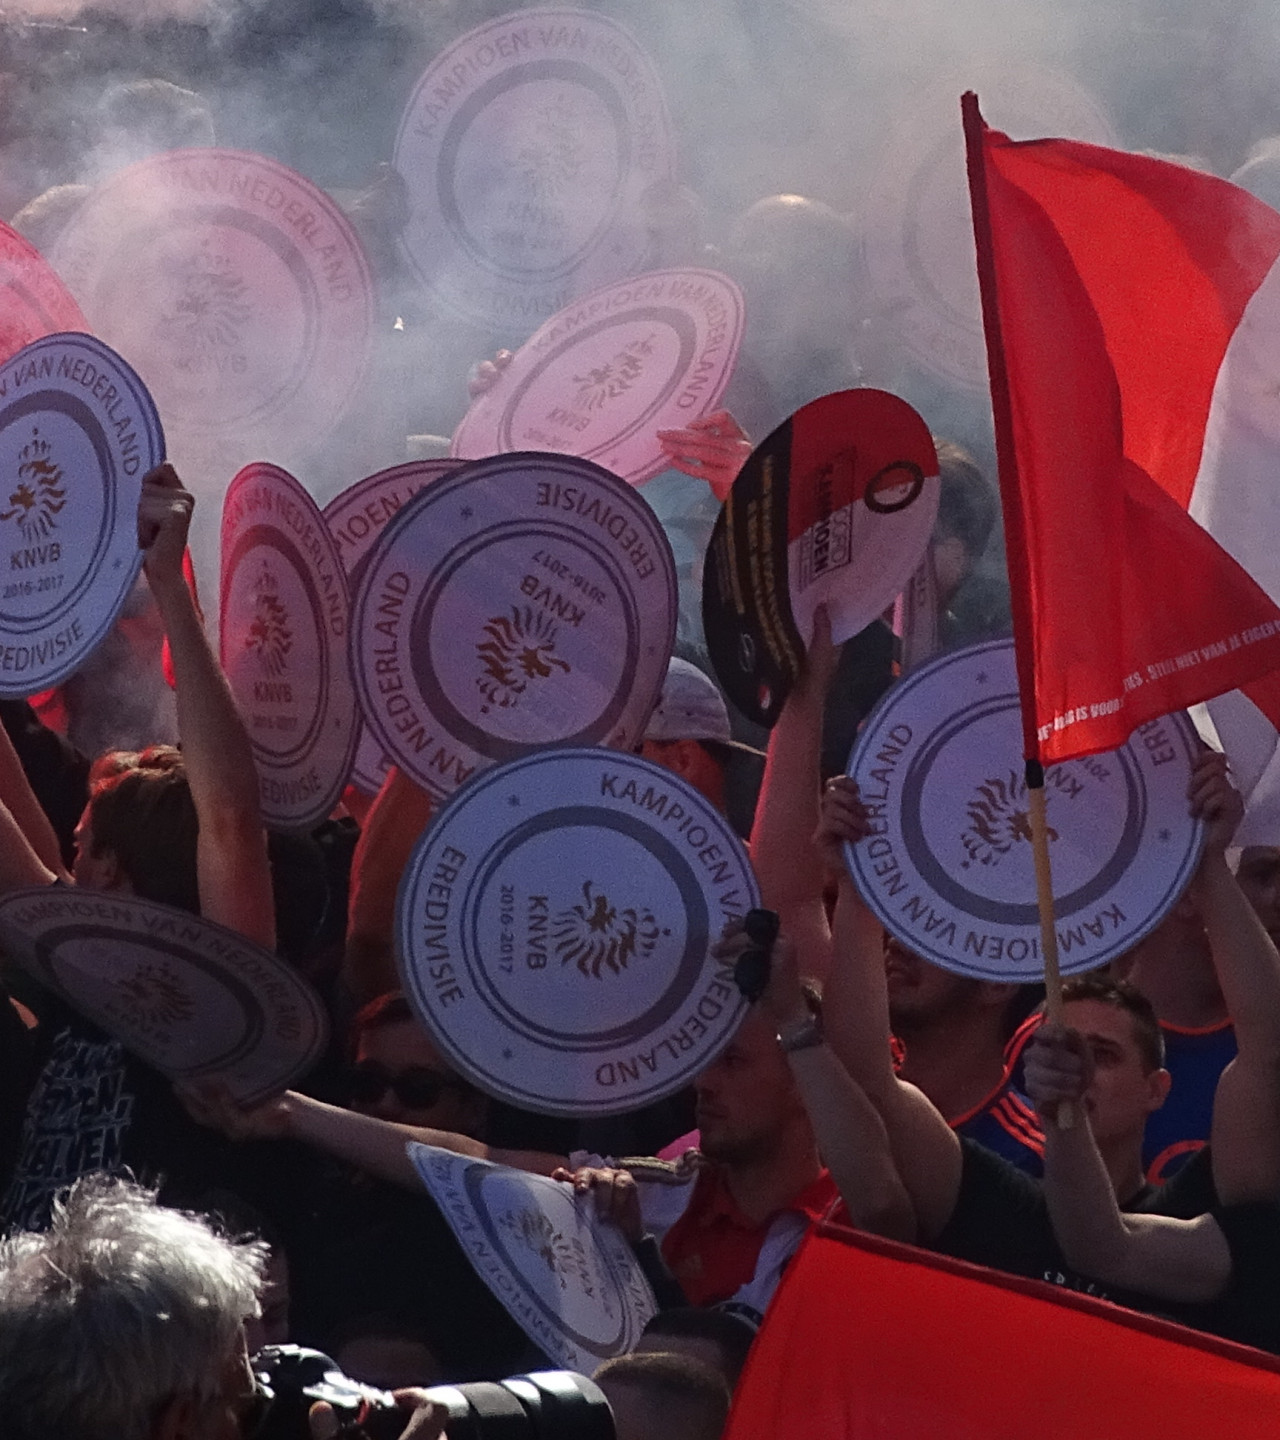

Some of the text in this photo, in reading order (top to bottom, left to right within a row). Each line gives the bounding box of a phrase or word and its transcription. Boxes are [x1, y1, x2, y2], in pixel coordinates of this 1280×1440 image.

[413, 27, 532, 140] KAMPIOEN
[228, 170, 354, 303] NEDERLAND
[531, 281, 666, 353] KAMPIOEN
[676, 290, 729, 410] NEDERLAND
[14, 358, 61, 388] VAN
[58, 354, 141, 477] NEDERLAND
[9, 543, 62, 571] KNVB
[275, 491, 346, 637] NEDERLAND
[531, 550, 608, 605] 2016-2017
[535, 481, 656, 581] EREDIVISIE
[2, 573, 66, 600] 2016-2017
[519, 574, 587, 628] KNVB
[253, 681, 293, 704] KNVB
[373, 570, 477, 787] AN NEDERLAND
[259, 766, 323, 808] EDIVISIE
[1045, 766, 1085, 800] KN
[866, 723, 1128, 962] KAMIOEN VAN NEDERLAND
[143, 913, 203, 944] VAN
[209, 939, 302, 1043] NEDERLAND
[423, 845, 468, 1009] EREDIVISIE
[498, 884, 515, 975] 2016-2017
[526, 895, 550, 971] KNVB
[595, 773, 744, 1088] KAMPIOEN VA NEDERLAND
